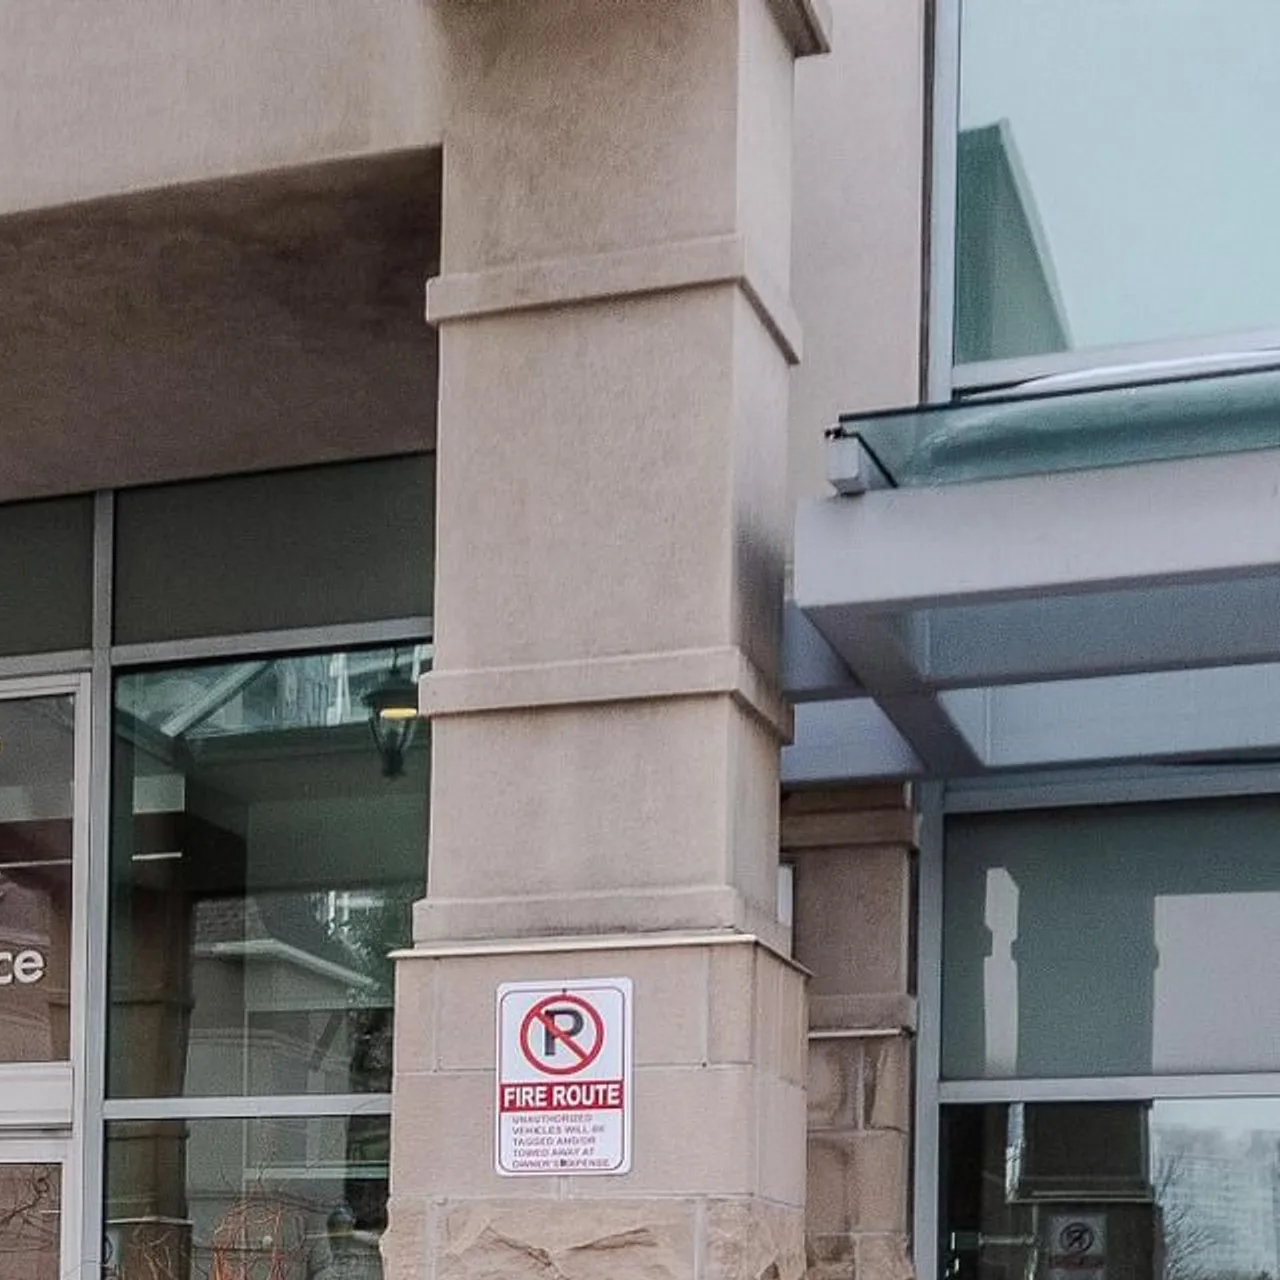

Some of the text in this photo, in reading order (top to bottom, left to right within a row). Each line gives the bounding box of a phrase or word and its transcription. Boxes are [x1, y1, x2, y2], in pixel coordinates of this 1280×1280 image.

[503, 1084, 620, 1108] FIRE ROUTE
[511, 1126, 561, 1135] VEHICLES
[513, 1137, 554, 1147] TAGGED
